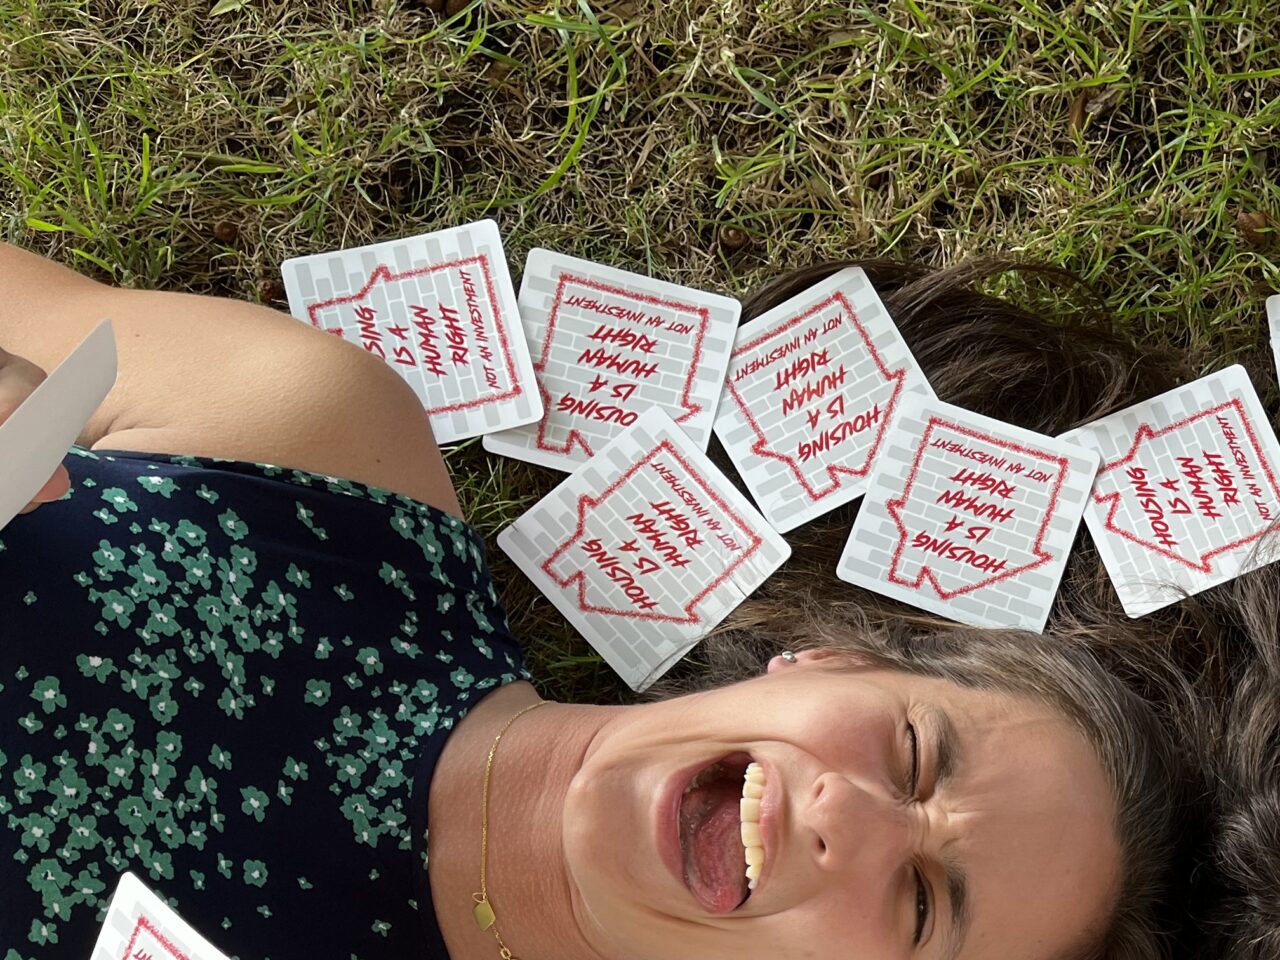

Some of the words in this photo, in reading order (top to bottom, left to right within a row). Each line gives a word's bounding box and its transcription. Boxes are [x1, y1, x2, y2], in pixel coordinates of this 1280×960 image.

[802, 327, 819, 344] AN
[821, 314, 844, 335] NOT
[734, 335, 802, 382] INVESTMENT
[773, 348, 831, 391] RIGHT
[781, 363, 847, 416] HUMAN
[806, 408, 821, 430] A
[824, 393, 845, 419] IS
[797, 403, 881, 463] HOUSING
[1214, 414, 1256, 480] INVESTMENT
[929, 437, 1007, 469] INVESTMENT
[1005, 461, 1025, 475] AN
[1024, 469, 1052, 484] NOT
[1201, 450, 1240, 506] RIGHT
[649, 461, 710, 518] INVESTMENT
[948, 467, 1016, 499] RIGHT
[1158, 477, 1180, 492] A
[1175, 455, 1222, 519] HUMAN
[1246, 481, 1262, 498] AN
[935, 488, 1015, 523] HUMAN
[1125, 466, 1178, 548] HOUSING
[1167, 495, 1193, 515] IS
[1253, 499, 1273, 522] NOT
[649, 499, 704, 549] RIGHT
[703, 517, 722, 532] AN
[943, 514, 965, 533] A
[964, 524, 992, 544] IS
[617, 537, 641, 553] A
[625, 511, 691, 567] HUMAN
[716, 533, 741, 553] NOT
[911, 530, 1007, 573] HOUSING
[580, 537, 658, 610] HOUSING
[632, 554, 661, 575] IS
